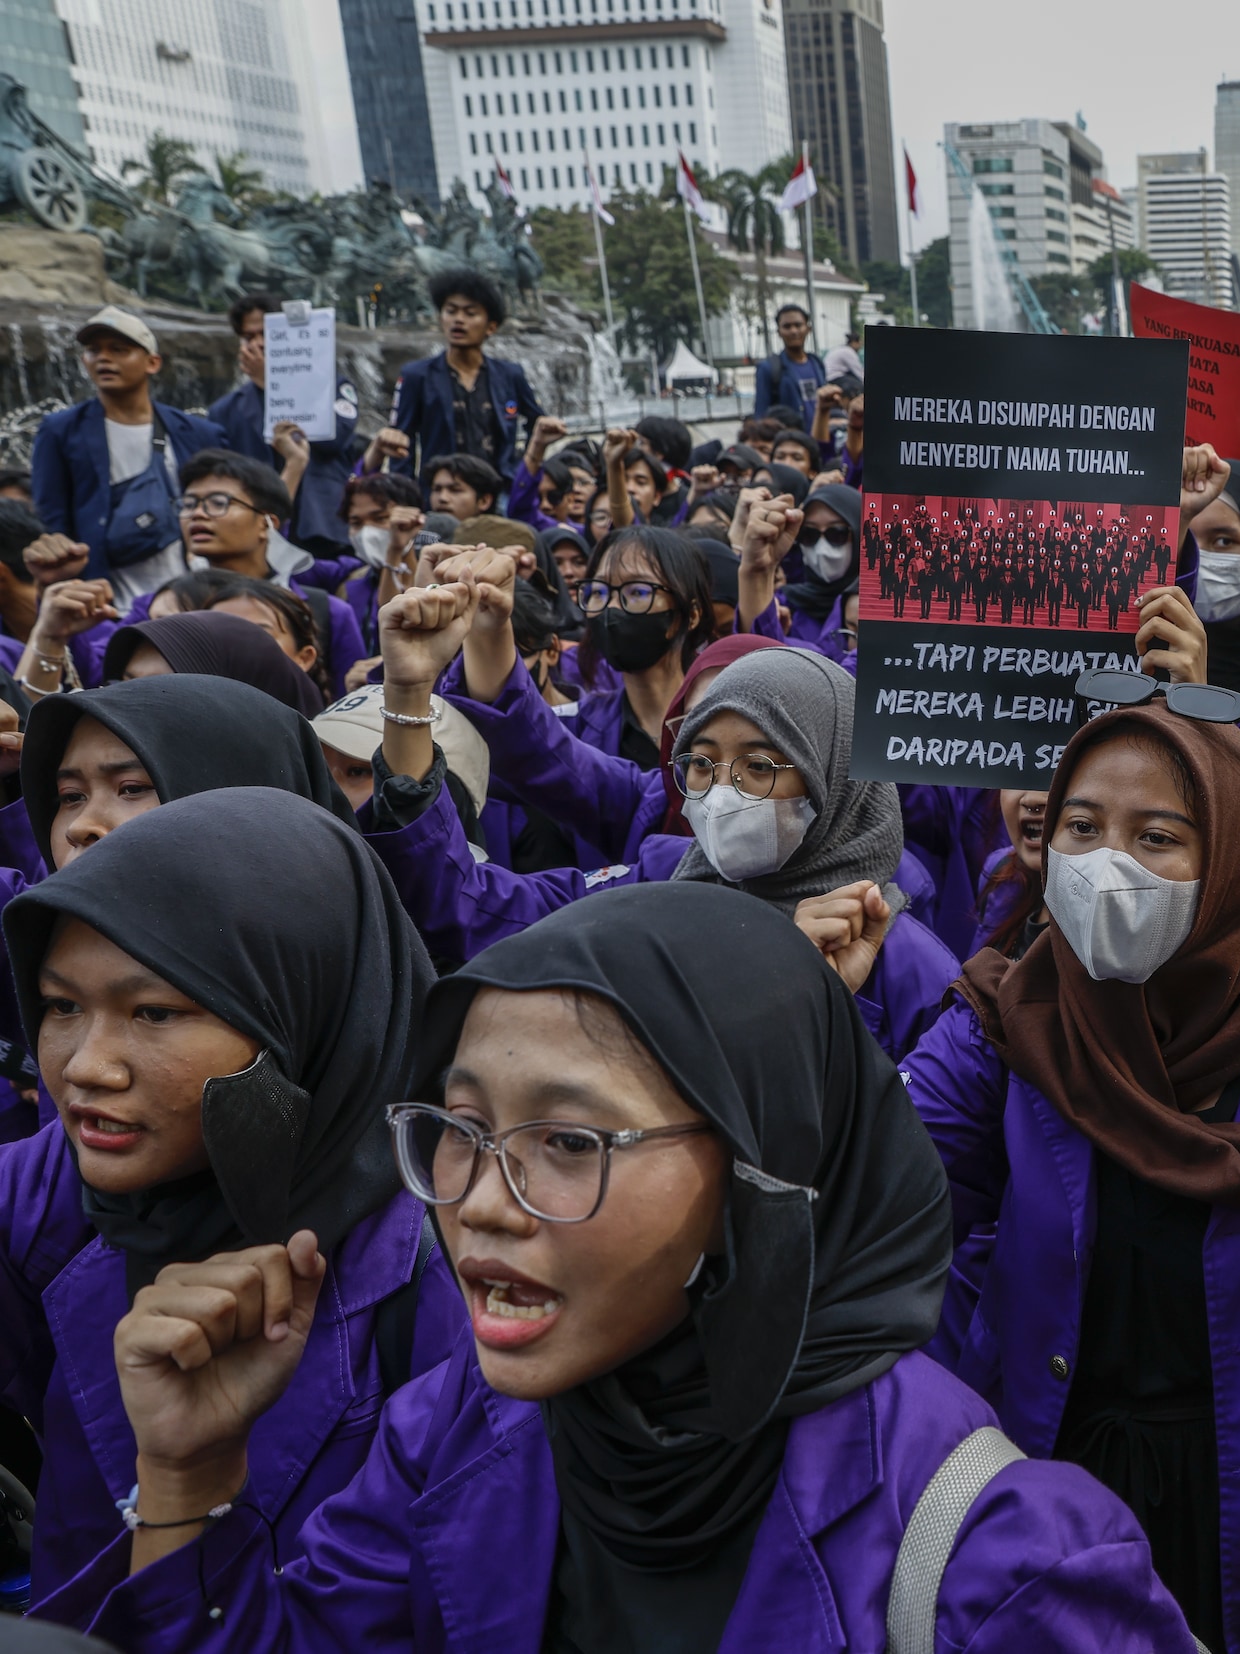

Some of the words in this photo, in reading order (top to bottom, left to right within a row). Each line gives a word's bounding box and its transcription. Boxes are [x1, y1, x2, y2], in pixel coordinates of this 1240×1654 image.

[270, 347, 313, 358] confusing
[1144, 316, 1171, 337] YANG
[1173, 328, 1240, 357] BERKUASA
[270, 364, 312, 375] everytime
[270, 398, 295, 410] being
[894, 396, 973, 424] MEREKA
[978, 401, 1074, 429] DISUMPAH
[1079, 404, 1155, 432] DENGAN
[900, 441, 1002, 469] MENYEBUT
[1006, 446, 1061, 472] NAMA
[1065, 448, 1145, 475] TUHAN...
[884, 643, 975, 672] ...TAPI
[983, 646, 1143, 677] PERBUATAN
[875, 689, 984, 721] MEREKA
[993, 695, 1074, 723] LEBIH
[886, 736, 1026, 770] DARIPADA
